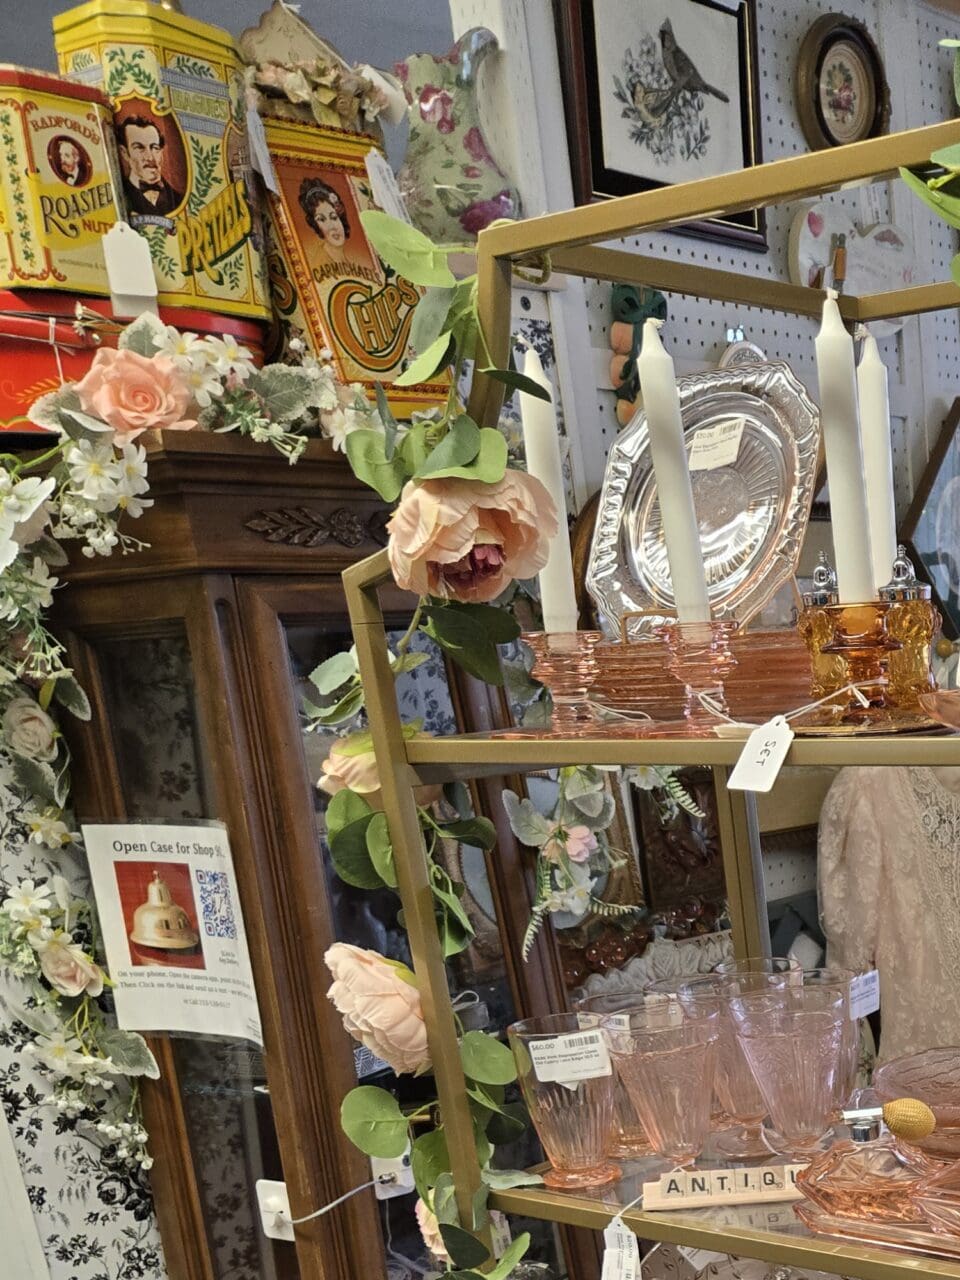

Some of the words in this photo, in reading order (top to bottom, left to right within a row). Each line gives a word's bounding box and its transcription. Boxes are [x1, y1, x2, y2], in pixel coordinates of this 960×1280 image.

[39, 182, 113, 239] ROASTED
[82, 219, 113, 235] NUT
[176, 180, 252, 286] PRETZELS
[328, 275, 420, 372] CHIPS
[755, 740, 777, 767] SET
[112, 840, 148, 855] Open
[150, 840, 174, 854] Case
[176, 841, 191, 855] for
[193, 842, 215, 858] Shop
